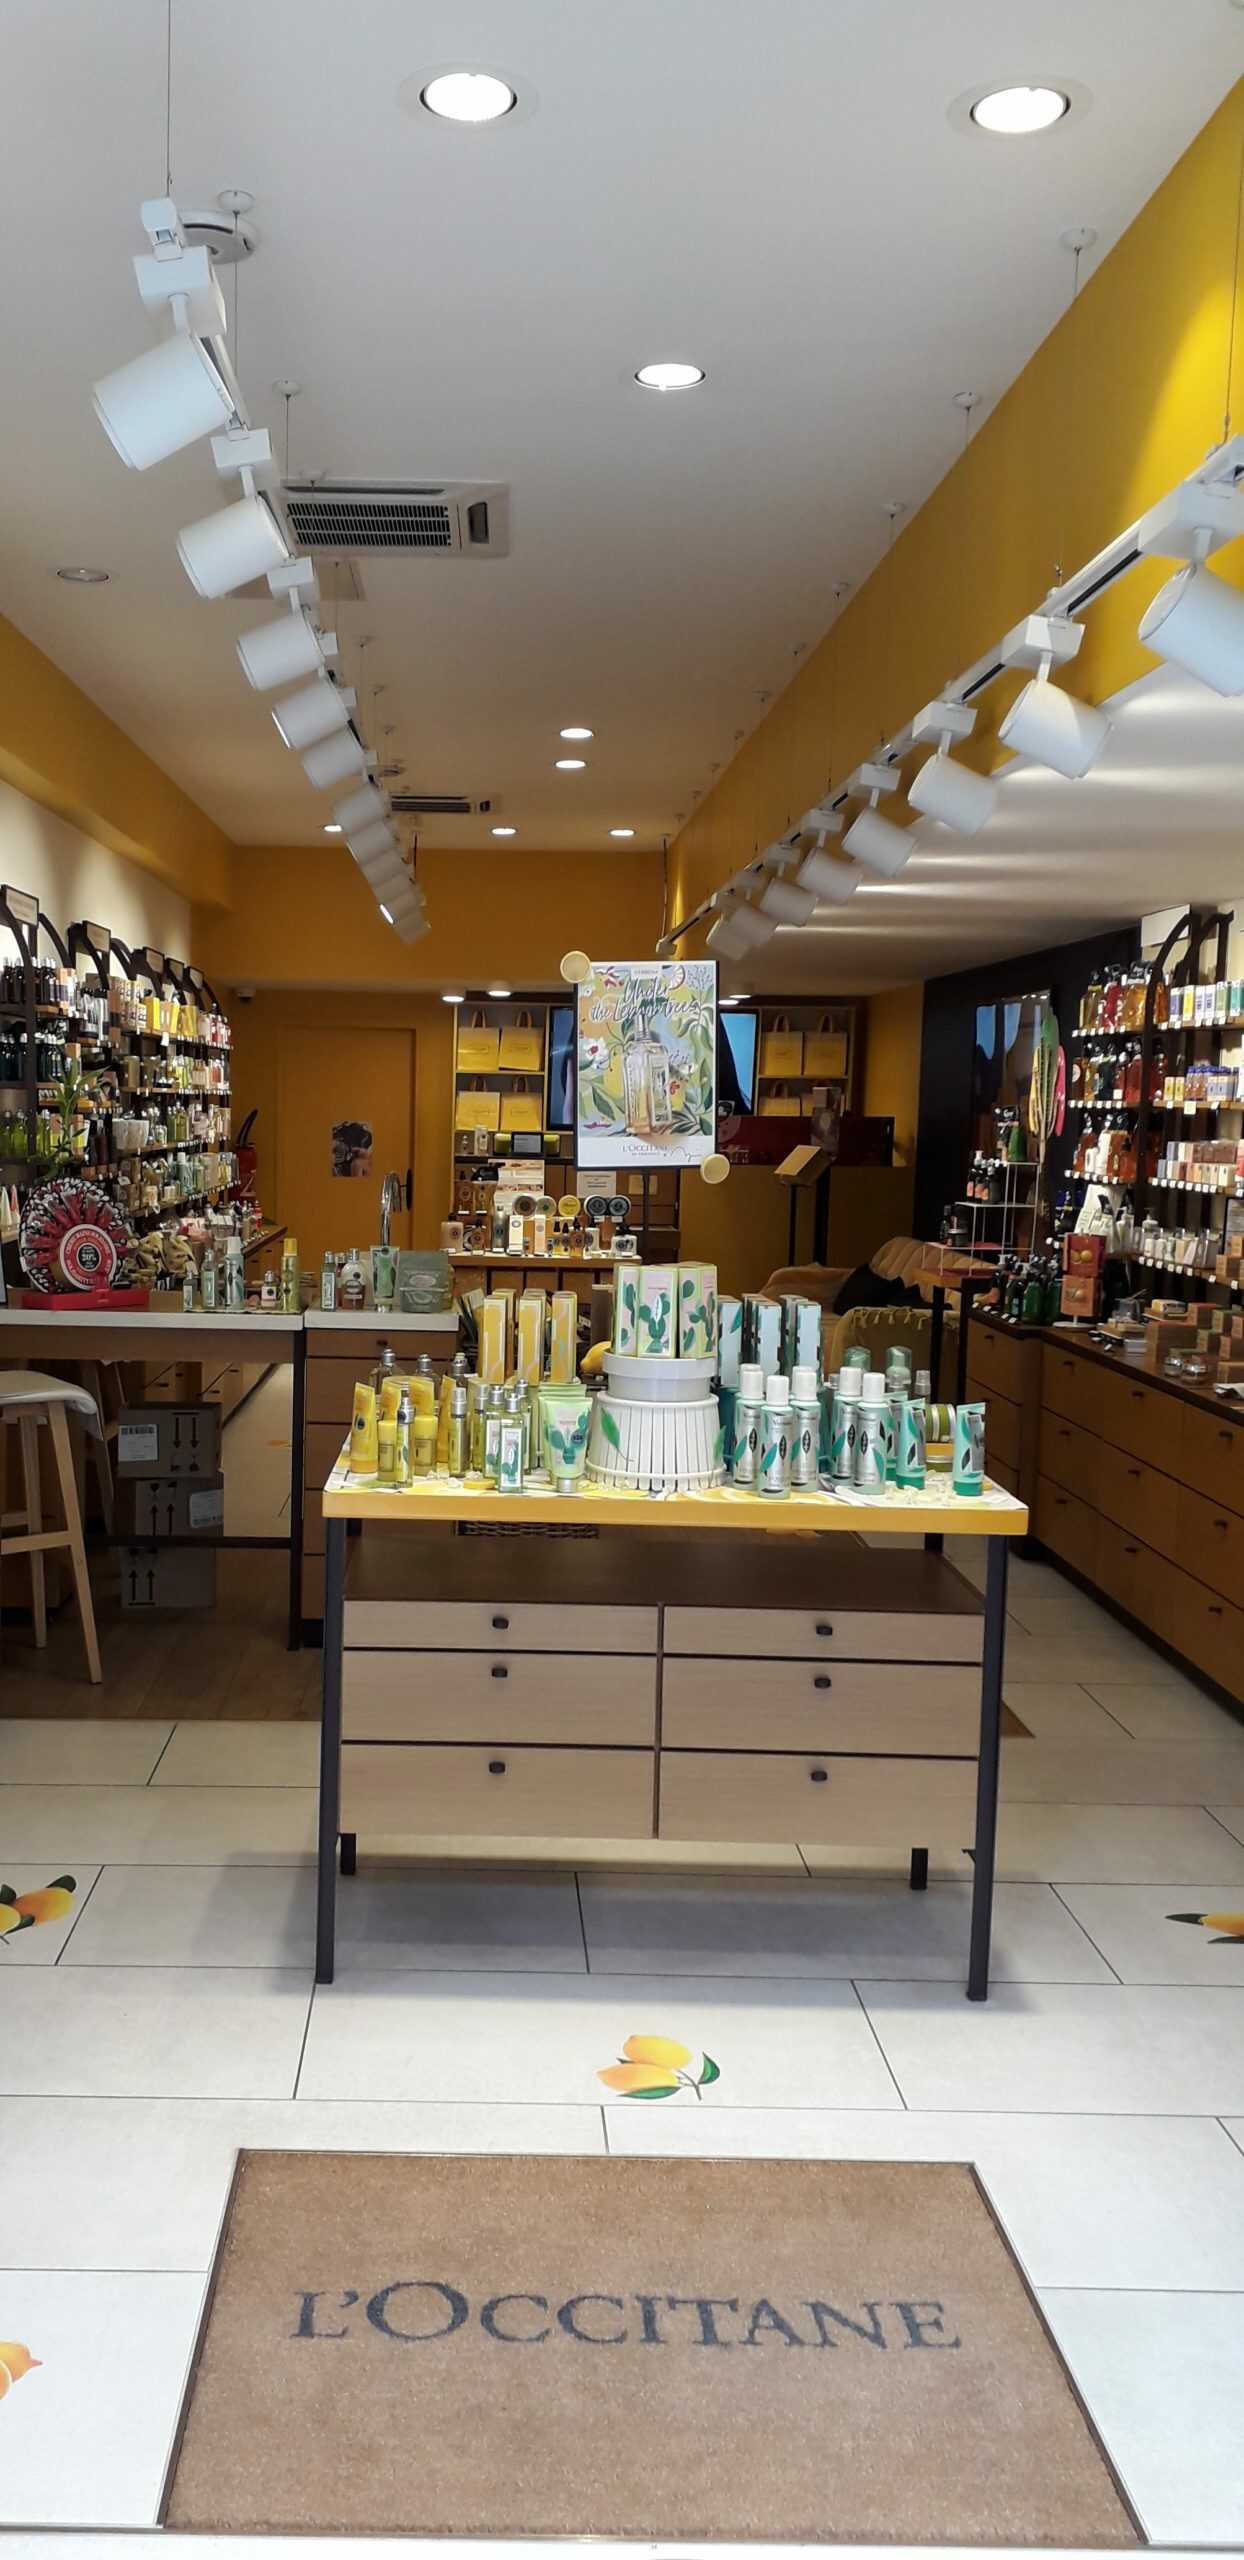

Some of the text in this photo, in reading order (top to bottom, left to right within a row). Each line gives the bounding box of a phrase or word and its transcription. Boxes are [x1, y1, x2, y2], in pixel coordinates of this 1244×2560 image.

[624, 976, 669, 1003] Under
[591, 1000, 612, 1022] the
[289, 2281, 962, 2349] L'OCCITANE
